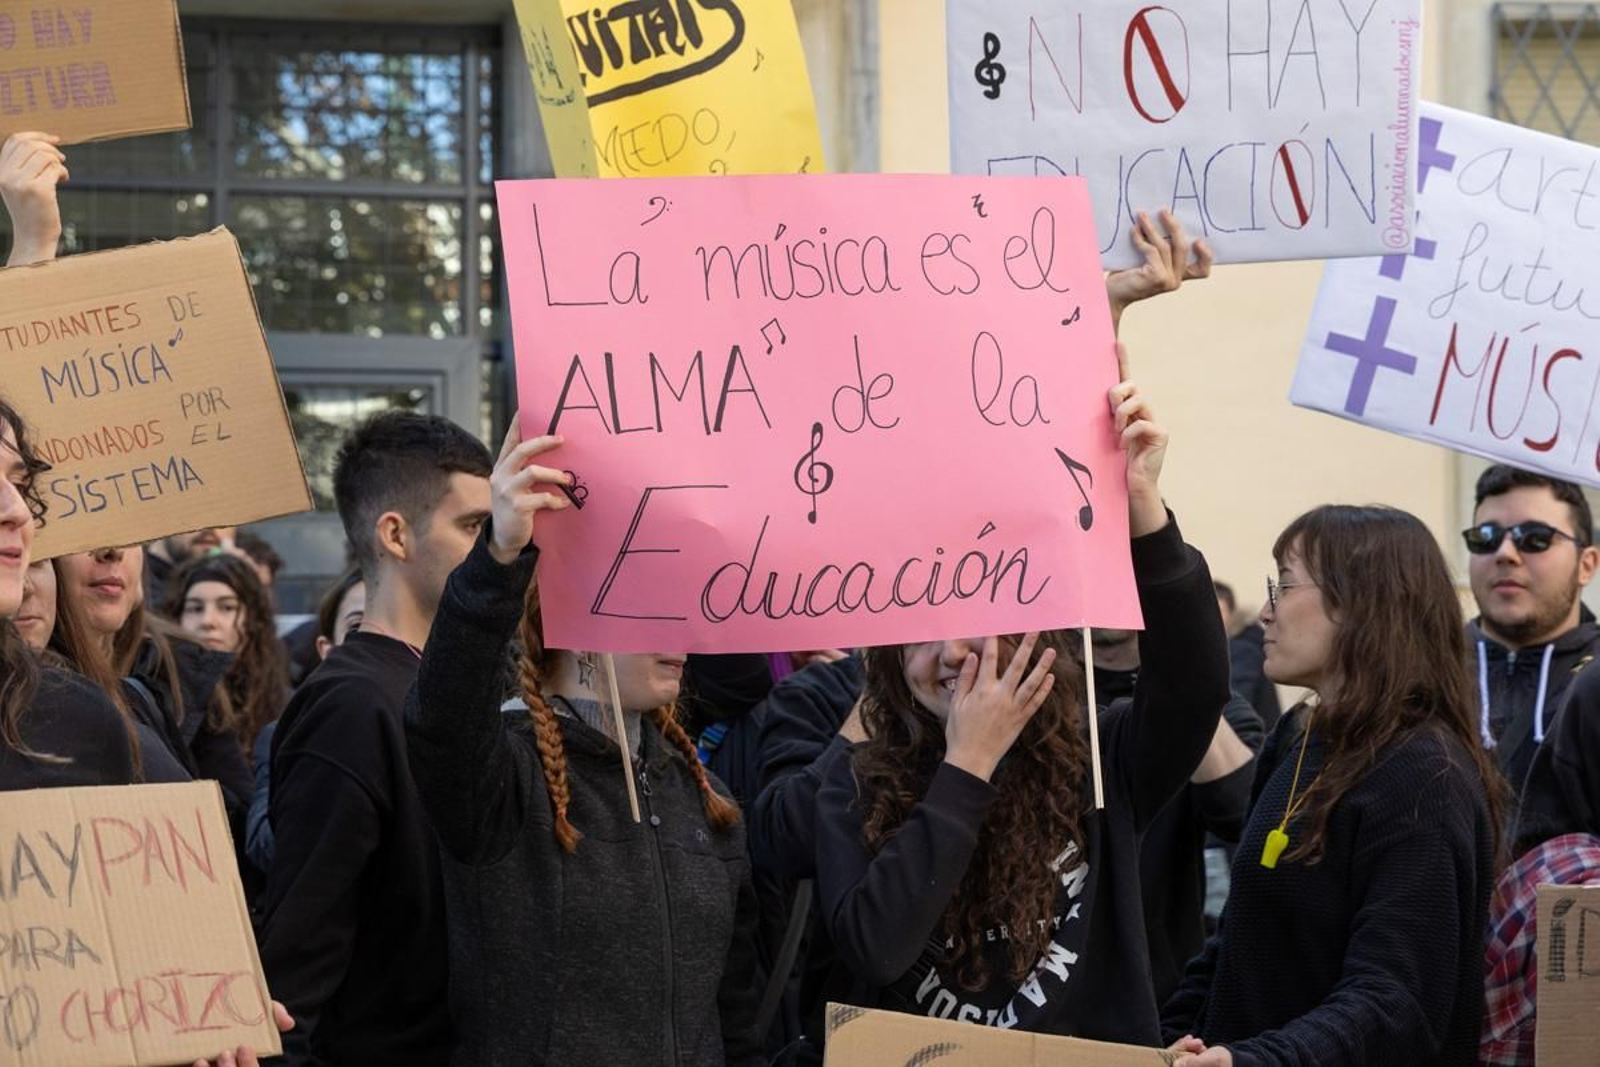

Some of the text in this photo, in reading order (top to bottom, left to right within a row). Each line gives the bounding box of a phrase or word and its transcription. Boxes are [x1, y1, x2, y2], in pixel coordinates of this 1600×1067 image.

[31, 8, 92, 48] HAY
[1028, 0, 1377, 124] NO HAY
[986, 122, 1376, 254] UCACIÓN
[532, 202, 1070, 306] La música es el
[166, 291, 203, 322] DE
[180, 385, 231, 421] POR
[191, 422, 232, 446] EL
[547, 330, 1050, 436] ALMA de la
[1428, 321, 1600, 474] MÚSI
[590, 484, 1051, 623] Educación
[0, 806, 218, 907] AY PAN
[0, 968, 267, 1052] O CHORIZO
